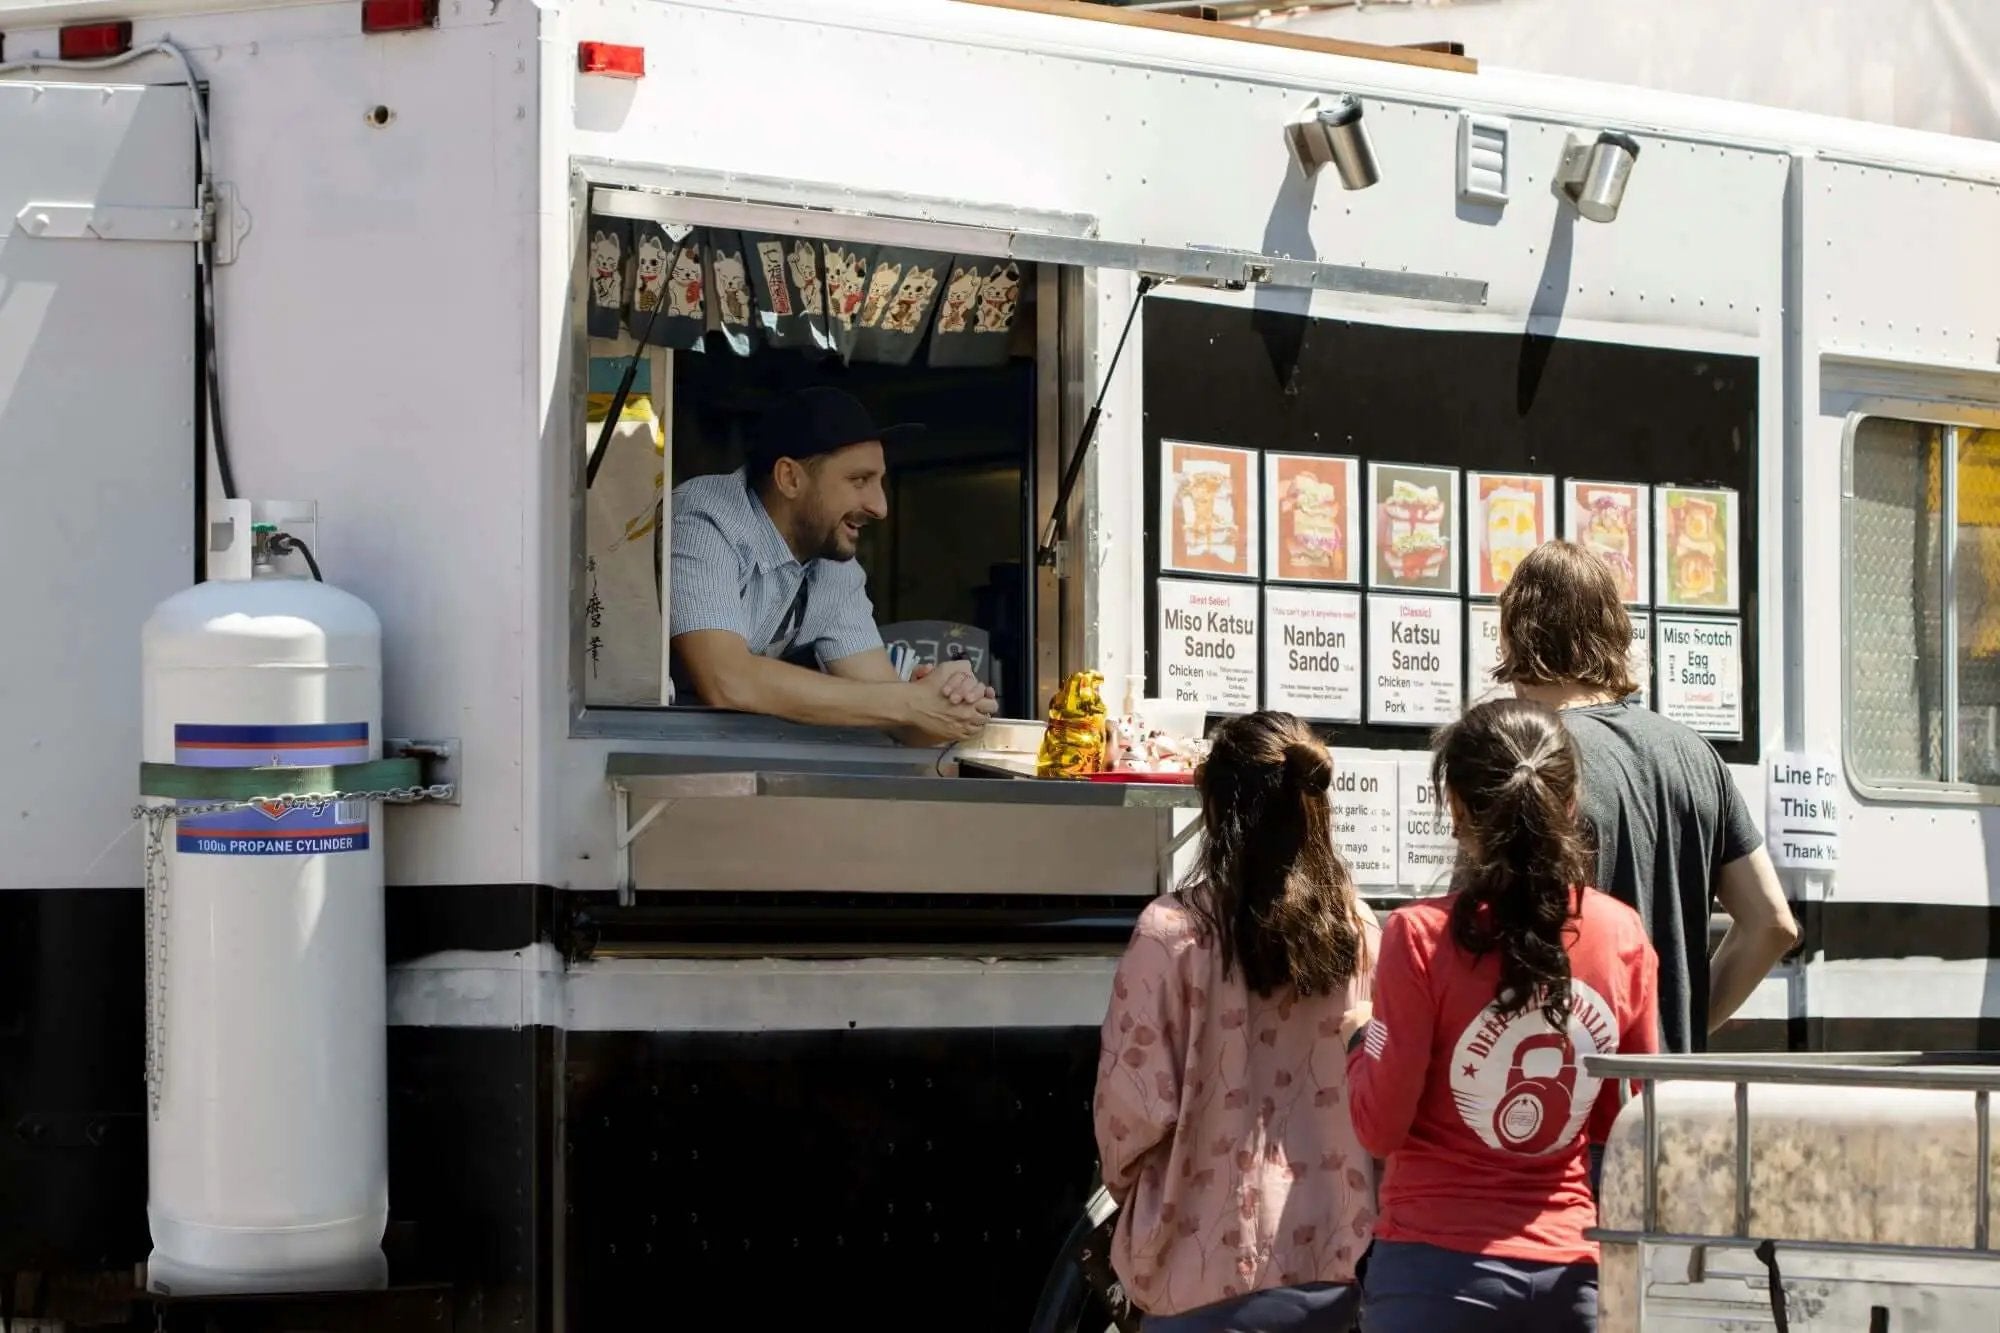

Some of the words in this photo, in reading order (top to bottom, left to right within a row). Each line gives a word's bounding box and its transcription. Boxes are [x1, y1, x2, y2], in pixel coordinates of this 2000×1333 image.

[1164, 608, 1202, 631] Miso
[1207, 611, 1254, 635] Katsu
[1283, 624, 1346, 649] Nanban
[1391, 621, 1440, 645] Katsu
[1482, 621, 1499, 641] Eg
[1664, 627, 1690, 645] Miso
[1694, 628, 1732, 648] Scotch
[1184, 635, 1235, 659] Sando
[1288, 649, 1340, 673] Sando
[1391, 649, 1440, 672] Sando
[1688, 650, 1709, 669] Egg
[1168, 663, 1204, 678] Chicken
[1681, 668, 1717, 686] Sando
[1377, 675, 1411, 688] Chicken
[1176, 688, 1199, 702] Pork
[1385, 699, 1406, 713] Pork
[1774, 764, 1812, 785] Line
[1816, 767, 1838, 787] For
[1360, 776, 1378, 793] on
[1345, 804, 1368, 817] garlic
[1780, 797, 1818, 818] This
[1821, 799, 1837, 820] Wa
[1407, 820, 1430, 835] UCC
[1433, 822, 1453, 836] Cof
[229, 840, 294, 852] PROPANE
[296, 837, 353, 852] CYLINDER
[1345, 843, 1368, 855] mayo
[1783, 843, 1824, 859] Thank
[1355, 861, 1380, 870] sauce
[1407, 851, 1444, 865] Ramune
